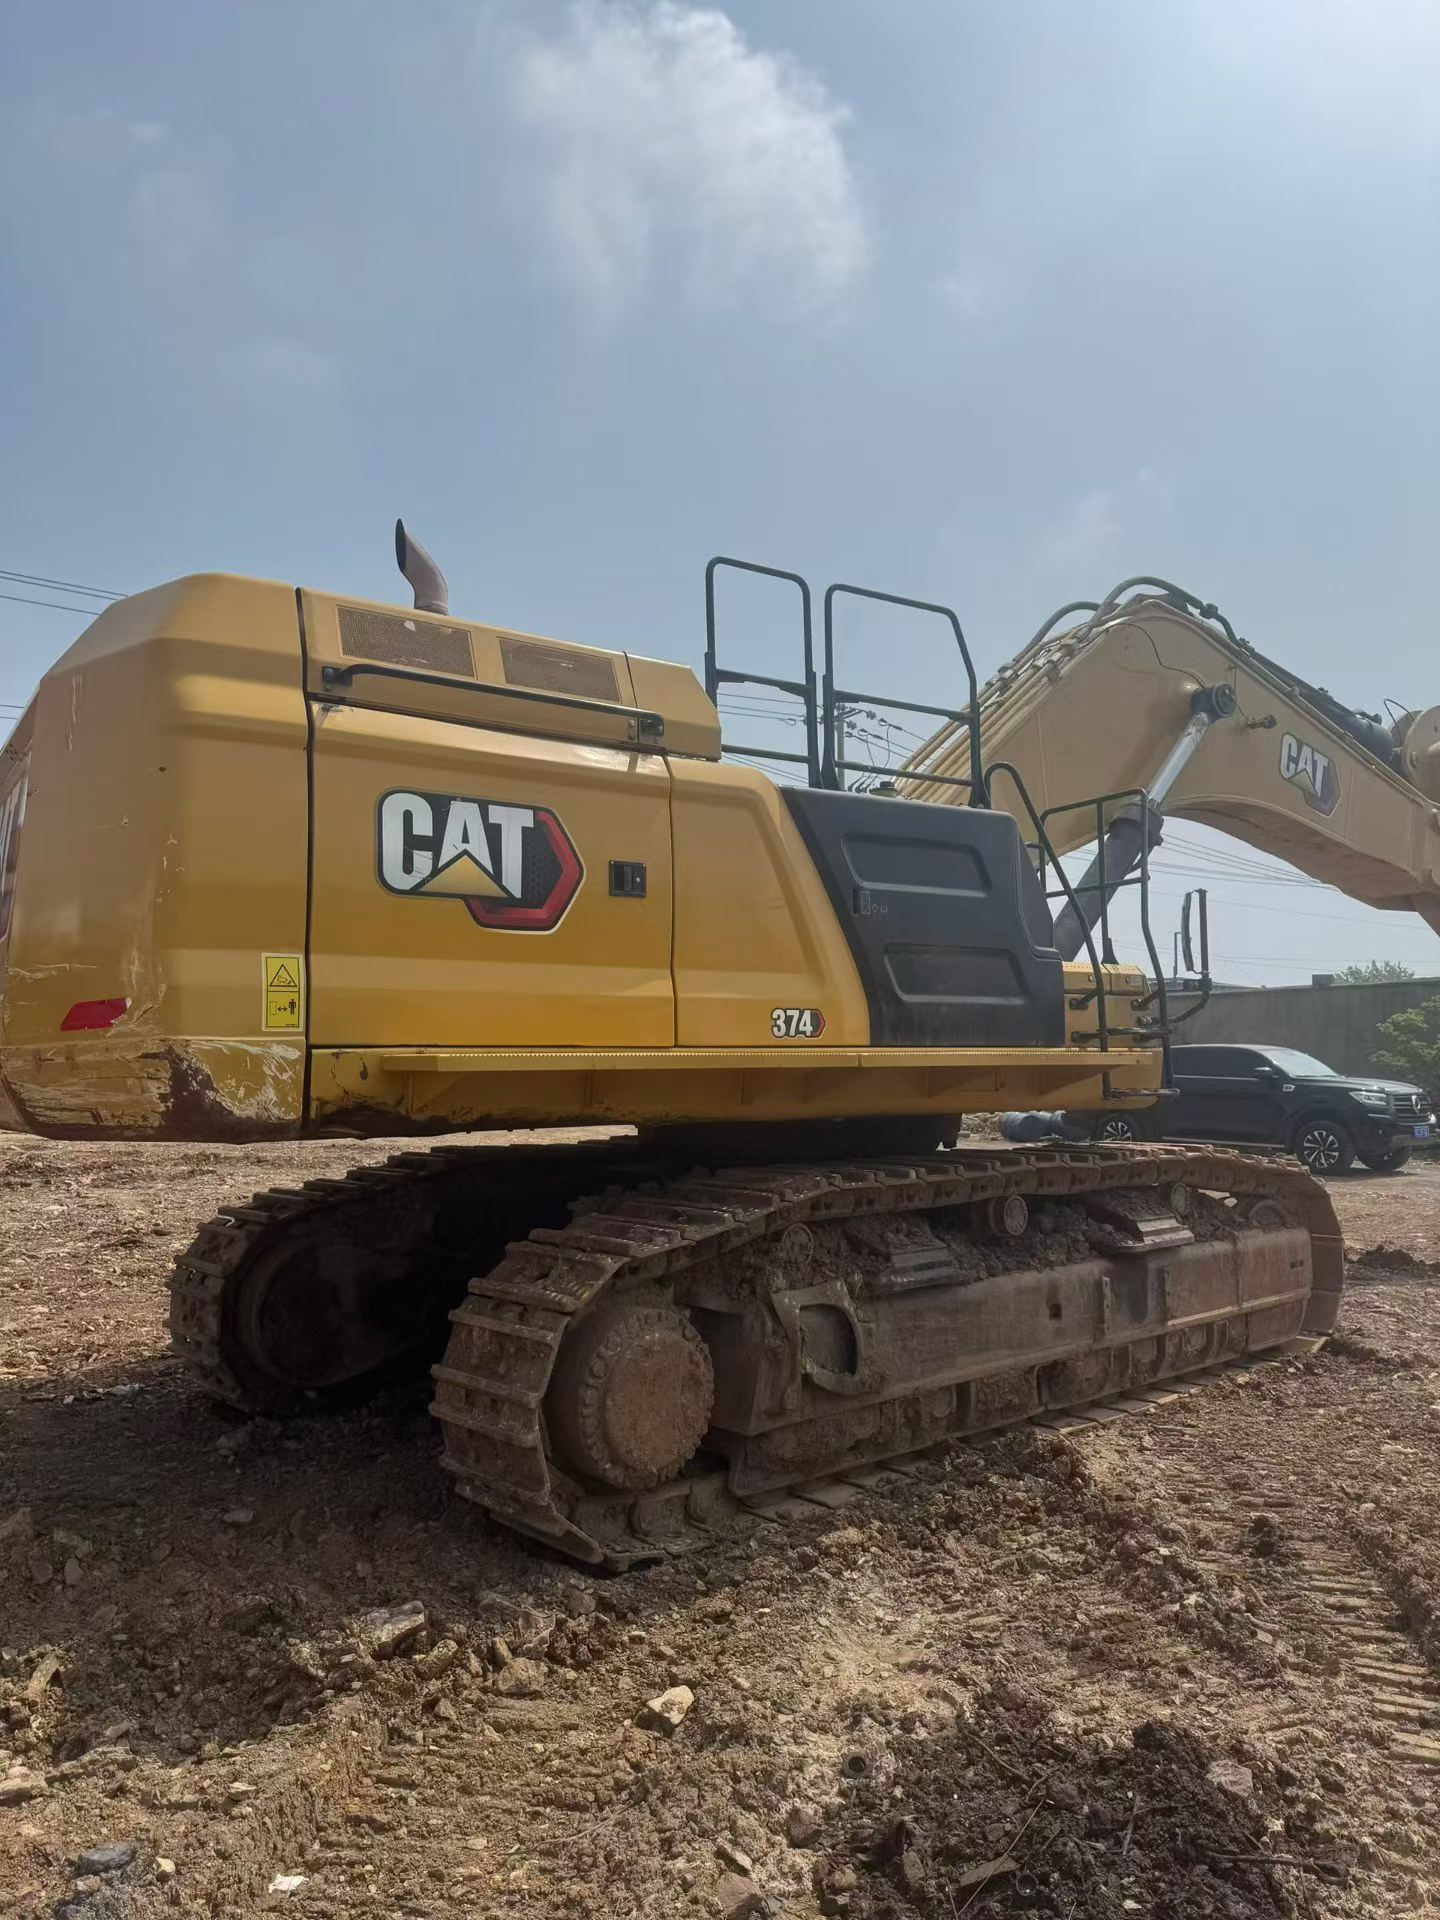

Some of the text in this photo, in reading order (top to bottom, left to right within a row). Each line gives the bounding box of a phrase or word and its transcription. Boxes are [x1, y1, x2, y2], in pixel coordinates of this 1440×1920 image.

[1280, 734, 1329, 797] CAT
[382, 793, 534, 899] CAT
[772, 1009, 813, 1037] 374
